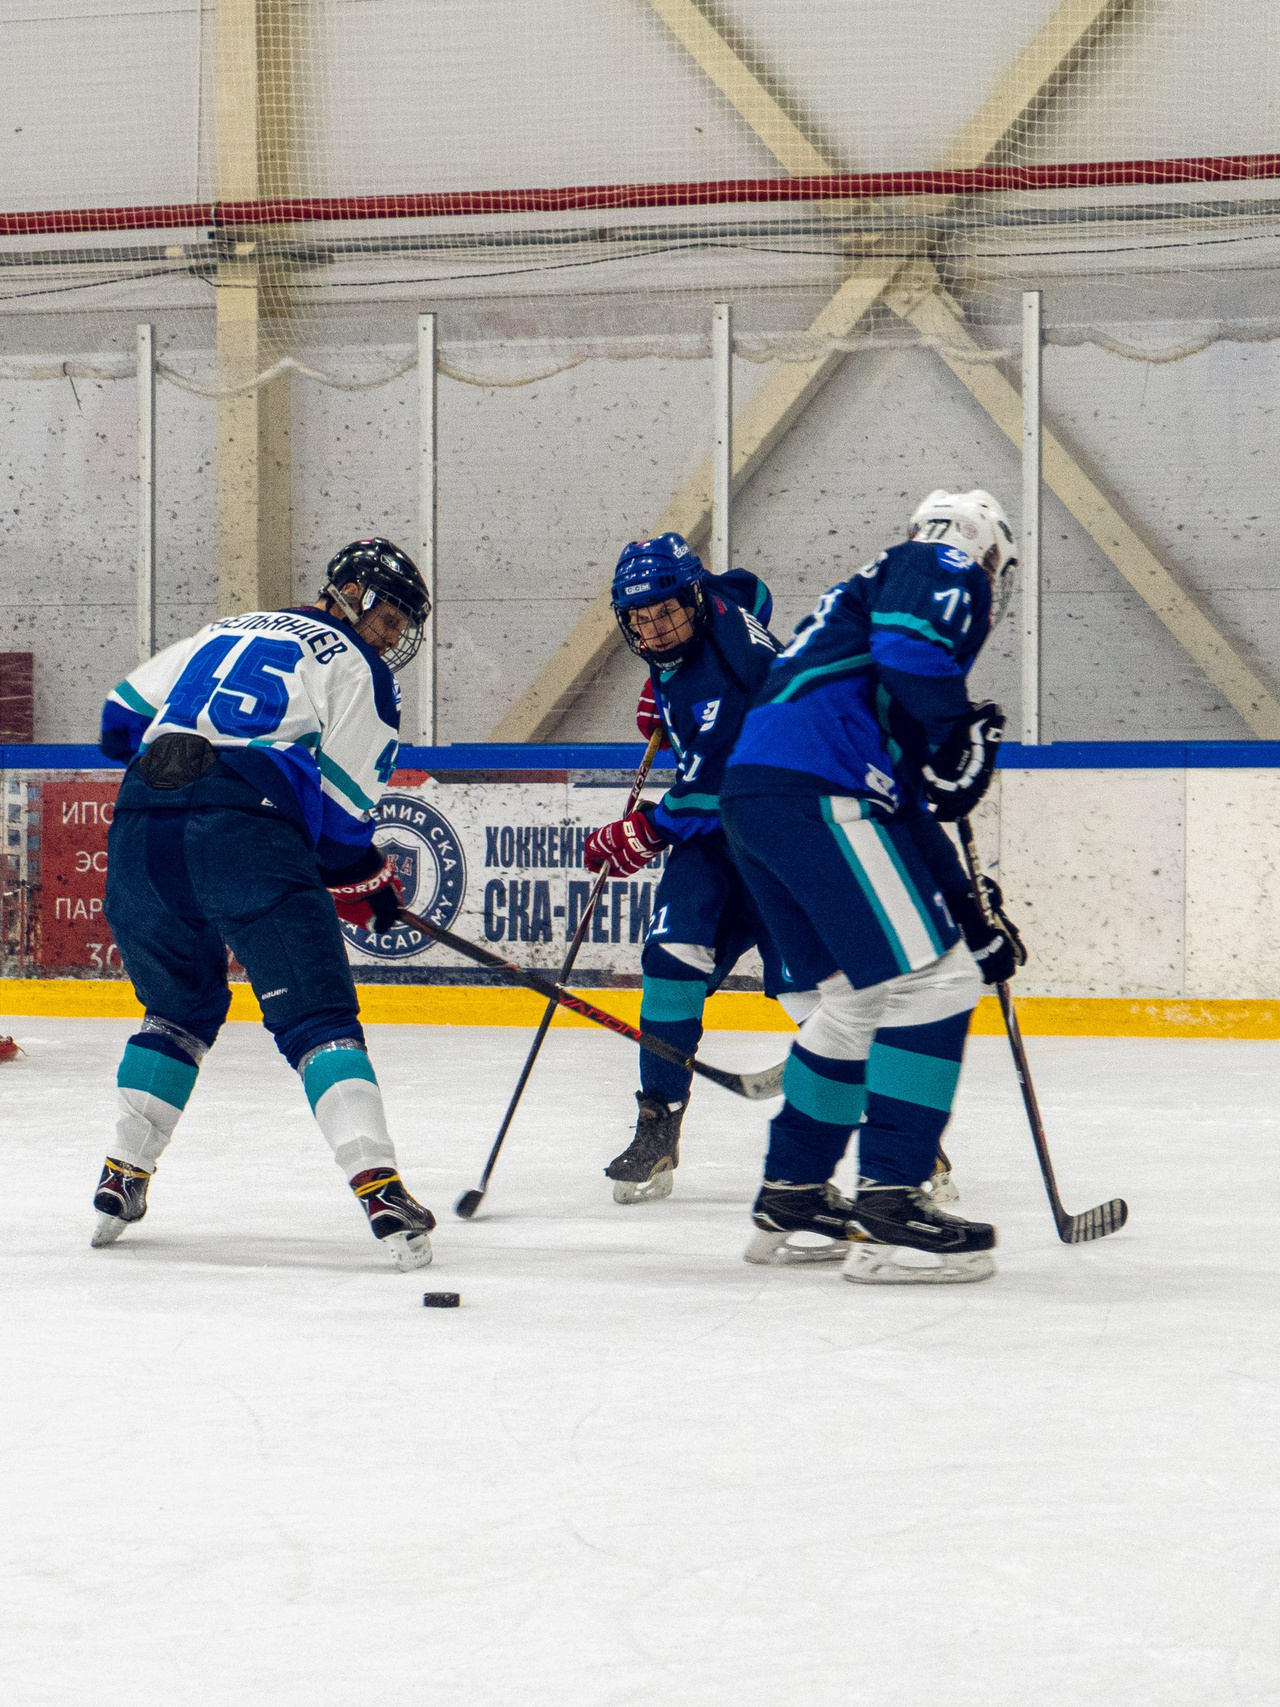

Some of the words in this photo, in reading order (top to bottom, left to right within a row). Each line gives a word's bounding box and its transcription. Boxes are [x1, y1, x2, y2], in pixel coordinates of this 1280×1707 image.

[157, 634, 305, 738] 45
[430, 827, 457, 871] СКА
[484, 879, 655, 944] СКА-ЛЕГИ
